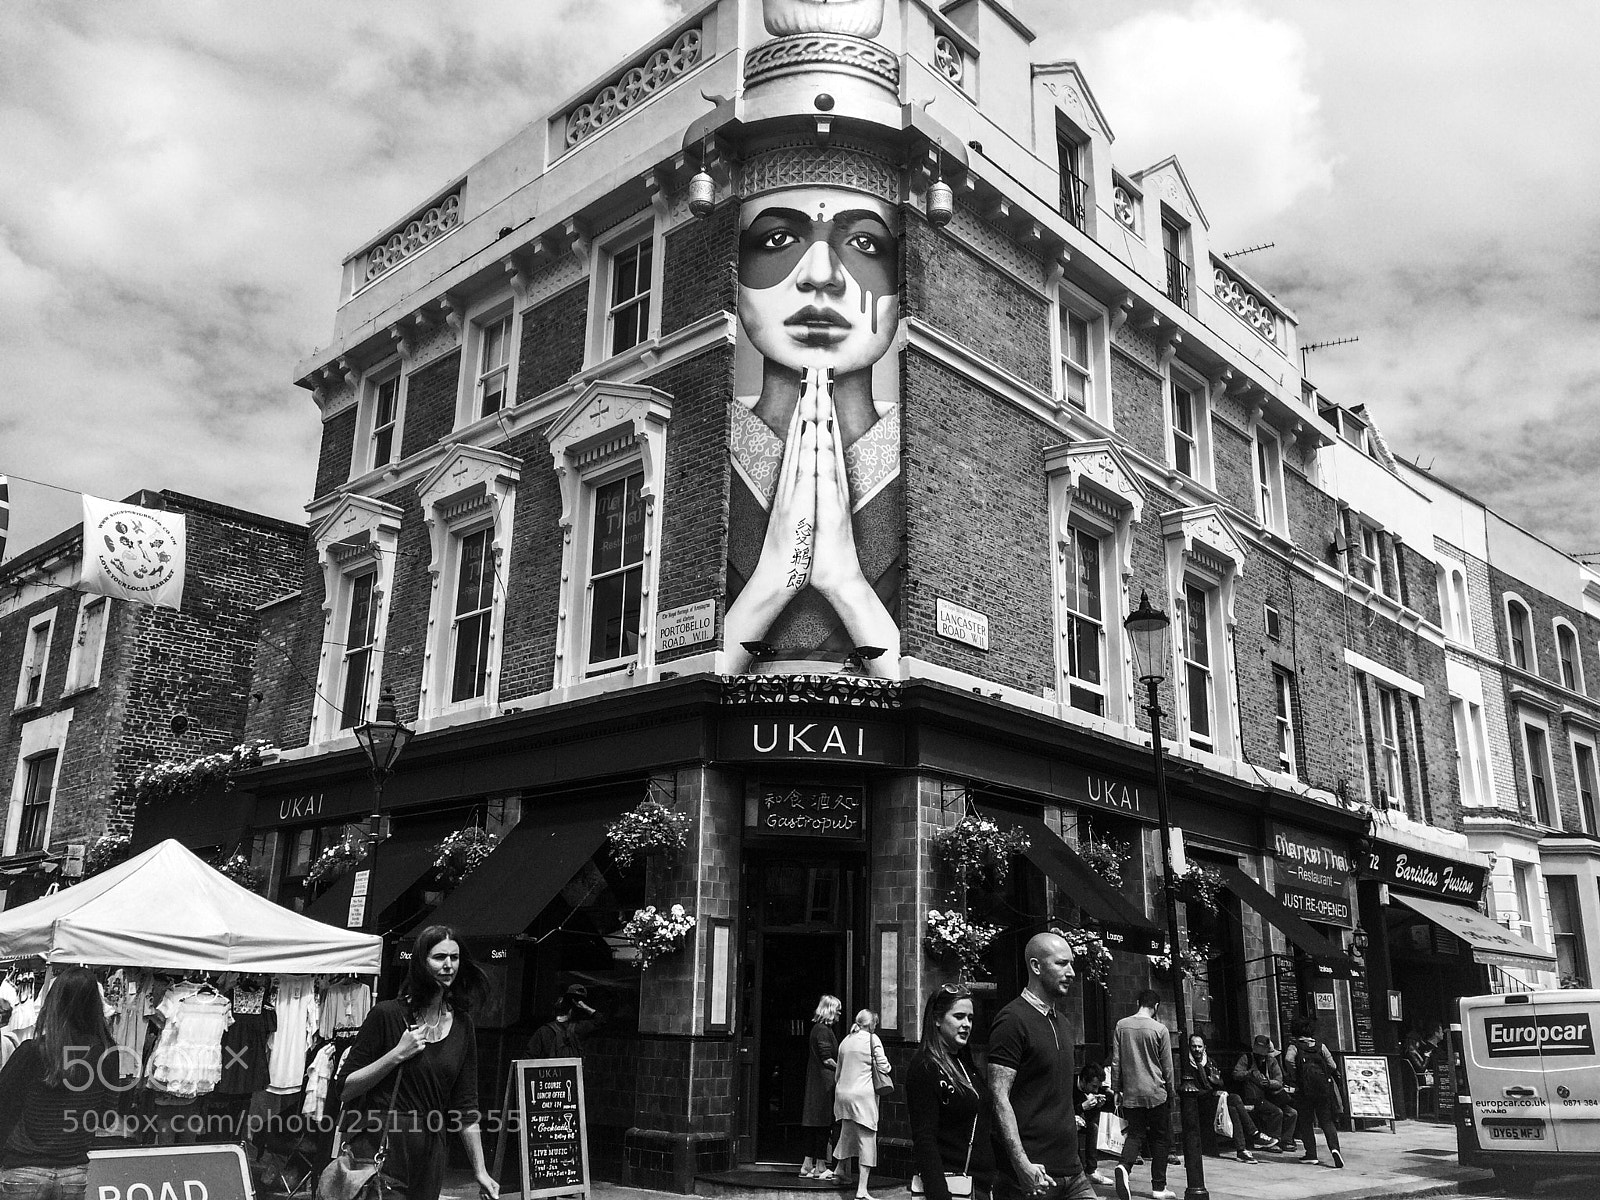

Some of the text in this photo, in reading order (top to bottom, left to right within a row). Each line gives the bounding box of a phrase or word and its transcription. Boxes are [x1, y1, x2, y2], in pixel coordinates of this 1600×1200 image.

[99, 555, 175, 592] LOVE YOUR LOCAL MARKET
[660, 617, 710, 639] PORTOBELLO
[940, 610, 986, 636] LANCASTER
[942, 622, 966, 639] ROAD
[753, 723, 864, 756] UKAI
[1087, 776, 1140, 812] UKAI
[279, 793, 324, 820] UKAI
[766, 813, 857, 834] Gastropub
[1275, 832, 1349, 872] Market Thai
[1369, 853, 1380, 870] 72
[1297, 865, 1333, 887] Restaurant
[1395, 853, 1474, 894] Baristas Fusion
[1282, 892, 1348, 918] JUST RE-OPENED
[1106, 930, 1124, 943] Lounge
[1151, 940, 1160, 949] Bar
[491, 949, 507, 959] Sushi
[1490, 1023, 1587, 1047] Europcar
[538, 1069, 562, 1079] UKAI
[539, 1081, 562, 1090] 3 COURSE
[551, 1090, 566, 1099] OFFER
[1475, 1097, 1547, 1109] europcar.co.uk
[1563, 1099, 1598, 1107] 0871 384
[1493, 1128, 1519, 1138] DY65
[533, 1148, 568, 1157] LIVE MUSIC
